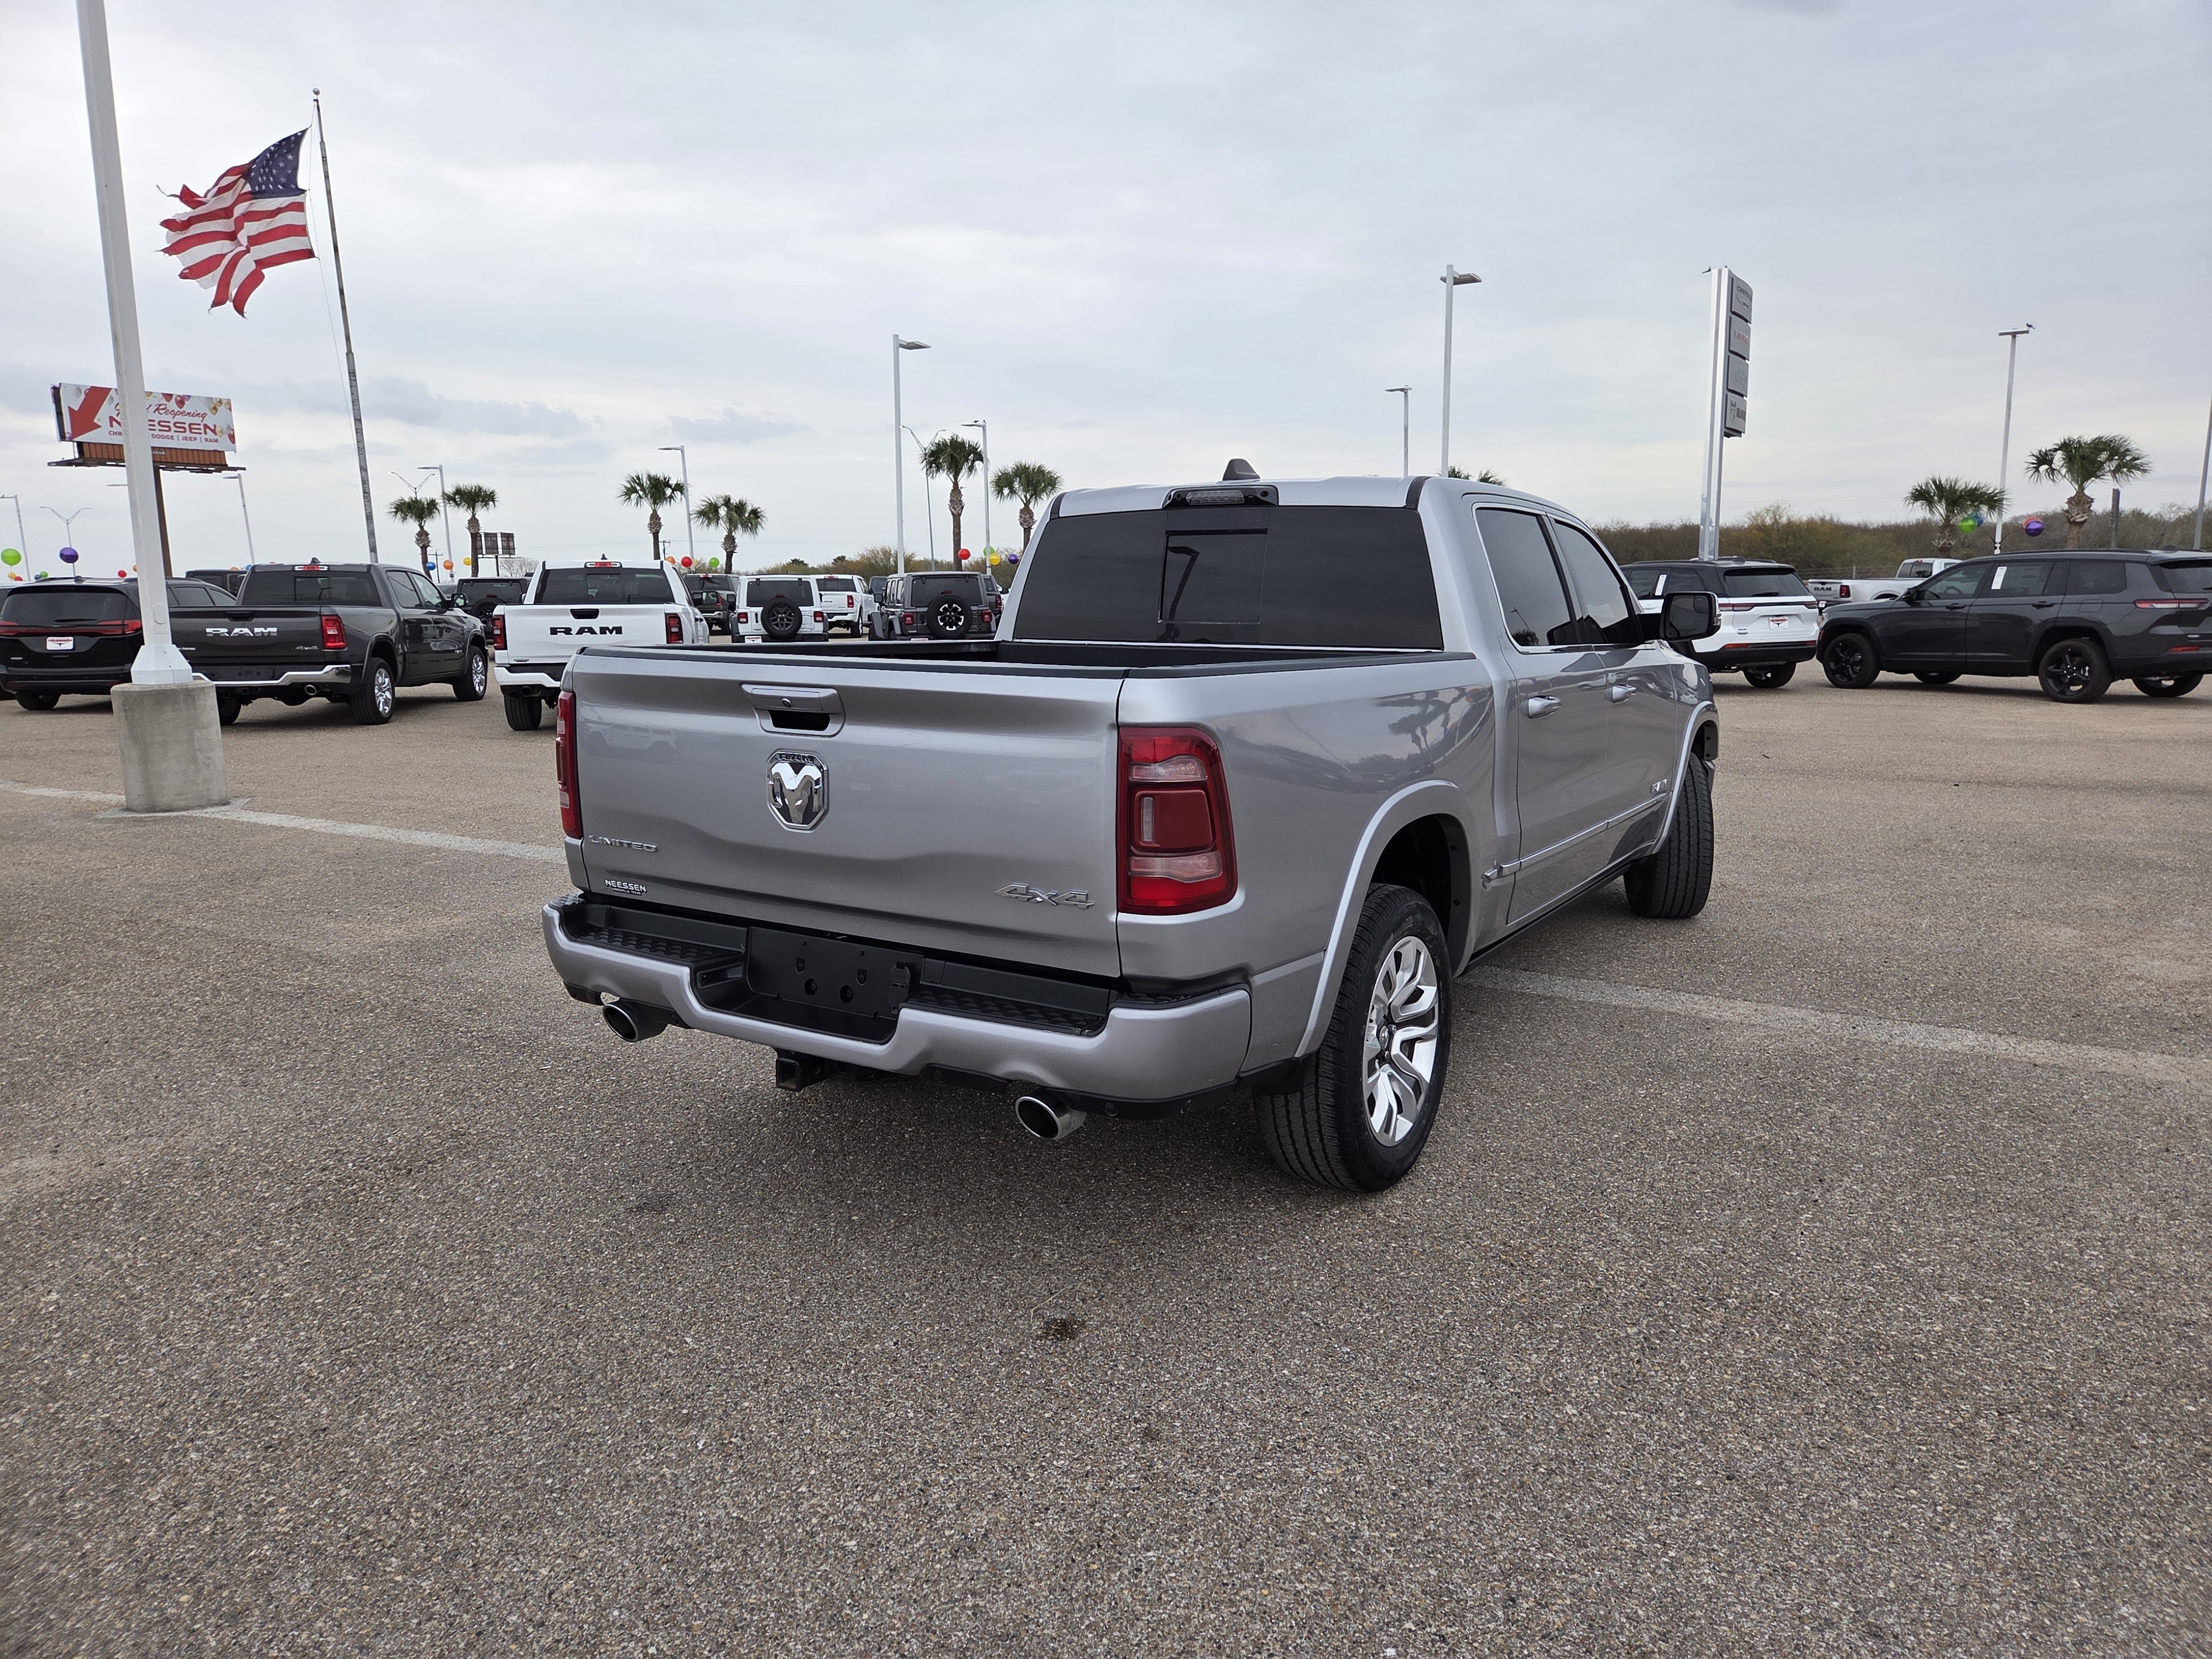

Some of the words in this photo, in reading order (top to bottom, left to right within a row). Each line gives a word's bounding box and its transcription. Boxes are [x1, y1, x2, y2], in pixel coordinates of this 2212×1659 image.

[153, 403, 208, 423] Reopening
[108, 415, 218, 436] NESSEN
[205, 628, 278, 636] RAM
[550, 626, 623, 635] RAM
[776, 753, 815, 763] RAM
[588, 835, 657, 852] LIMITED
[605, 879, 646, 893] NEESSEN
